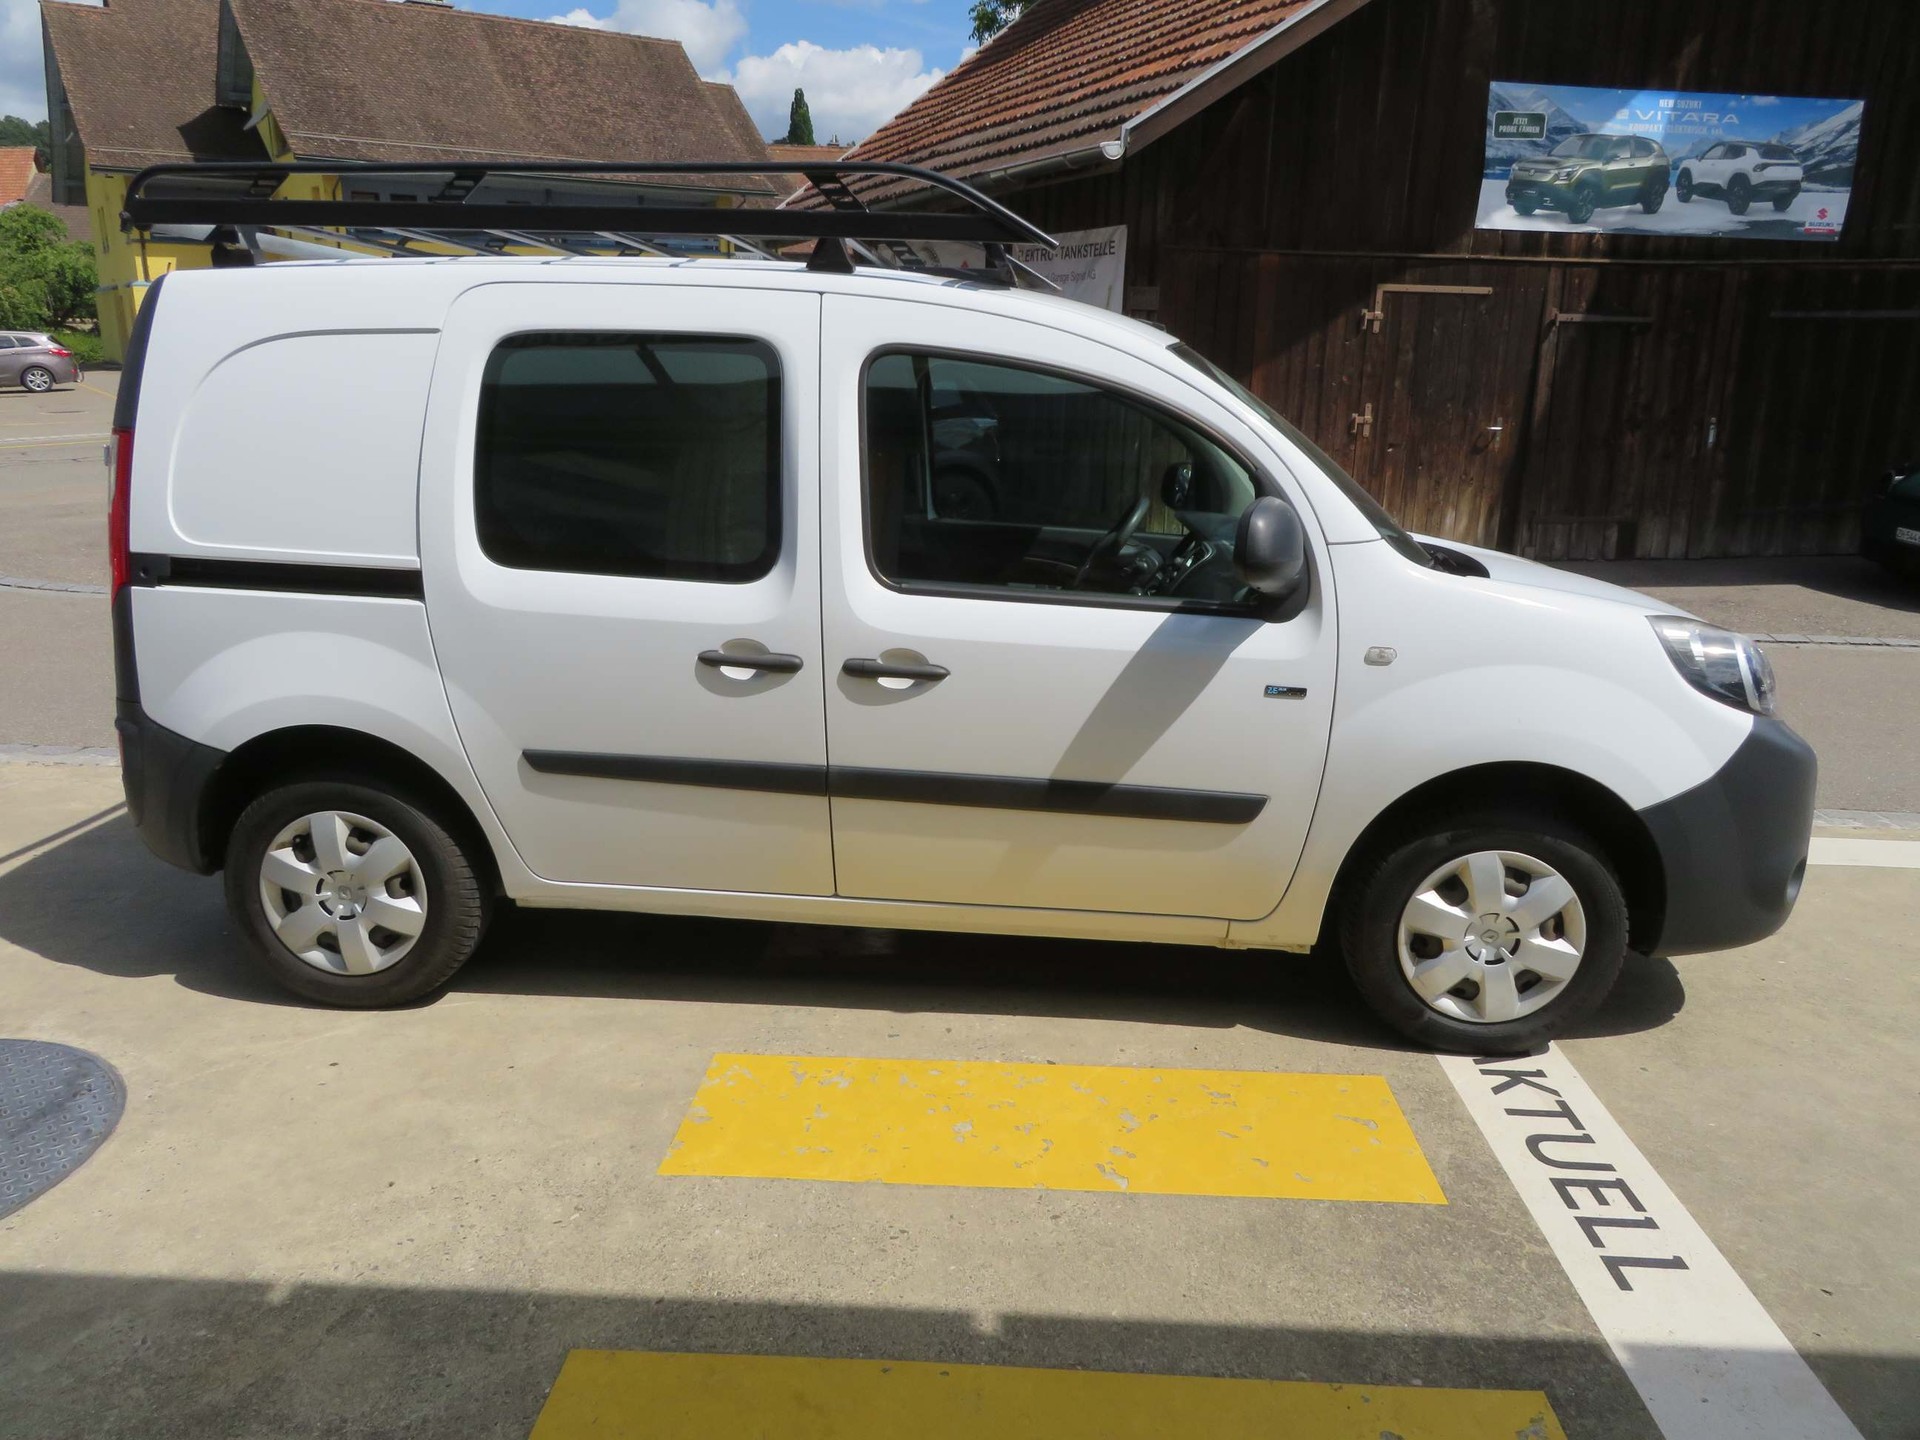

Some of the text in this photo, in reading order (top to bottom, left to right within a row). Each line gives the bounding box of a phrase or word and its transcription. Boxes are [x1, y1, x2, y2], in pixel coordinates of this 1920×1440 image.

[1676, 100, 1702, 110] SUZUKI
[1636, 110, 1740, 125] VITARA
[1472, 1057, 1690, 1292] KTUELL
